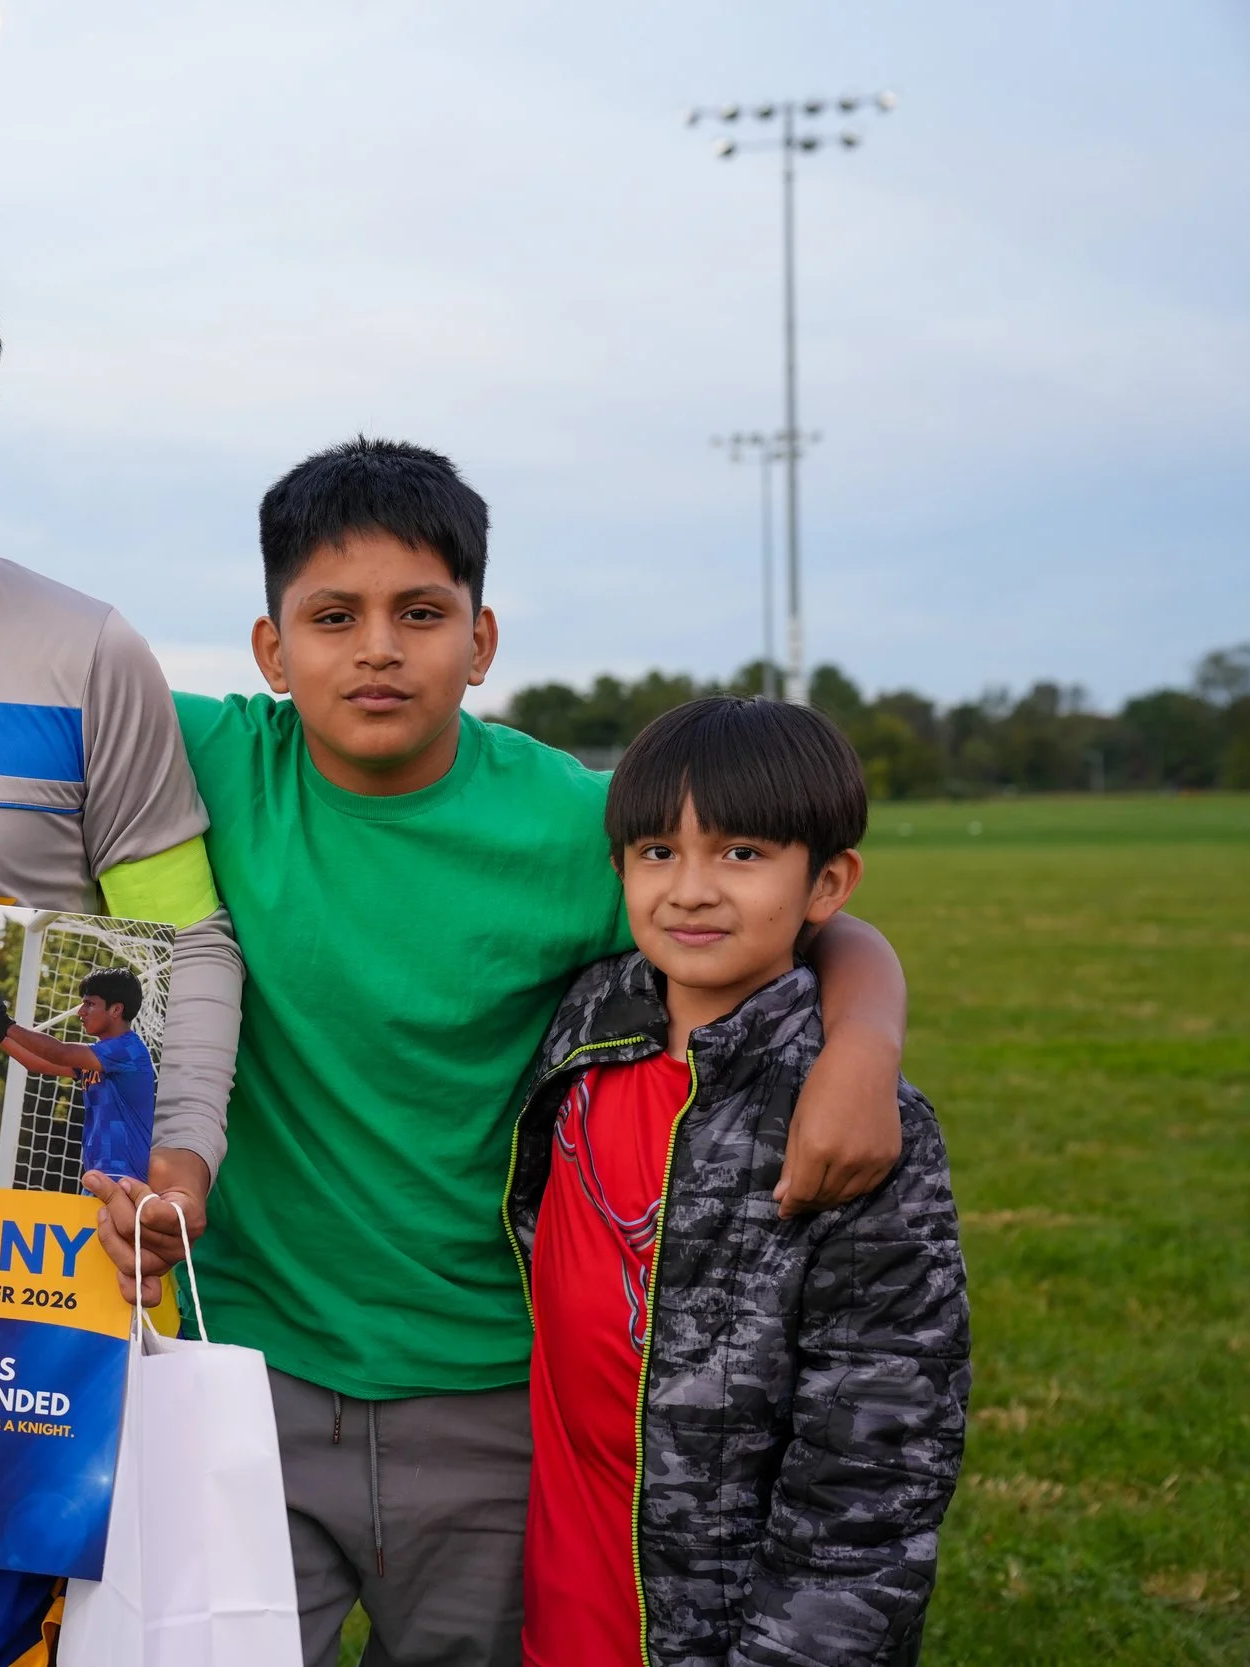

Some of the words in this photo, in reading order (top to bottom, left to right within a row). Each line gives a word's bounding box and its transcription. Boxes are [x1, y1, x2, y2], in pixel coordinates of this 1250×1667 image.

[21, 1288, 78, 1310] 2026
[3, 1419, 15, 1432] A
[18, 1421, 75, 1438] KNIGHT.
